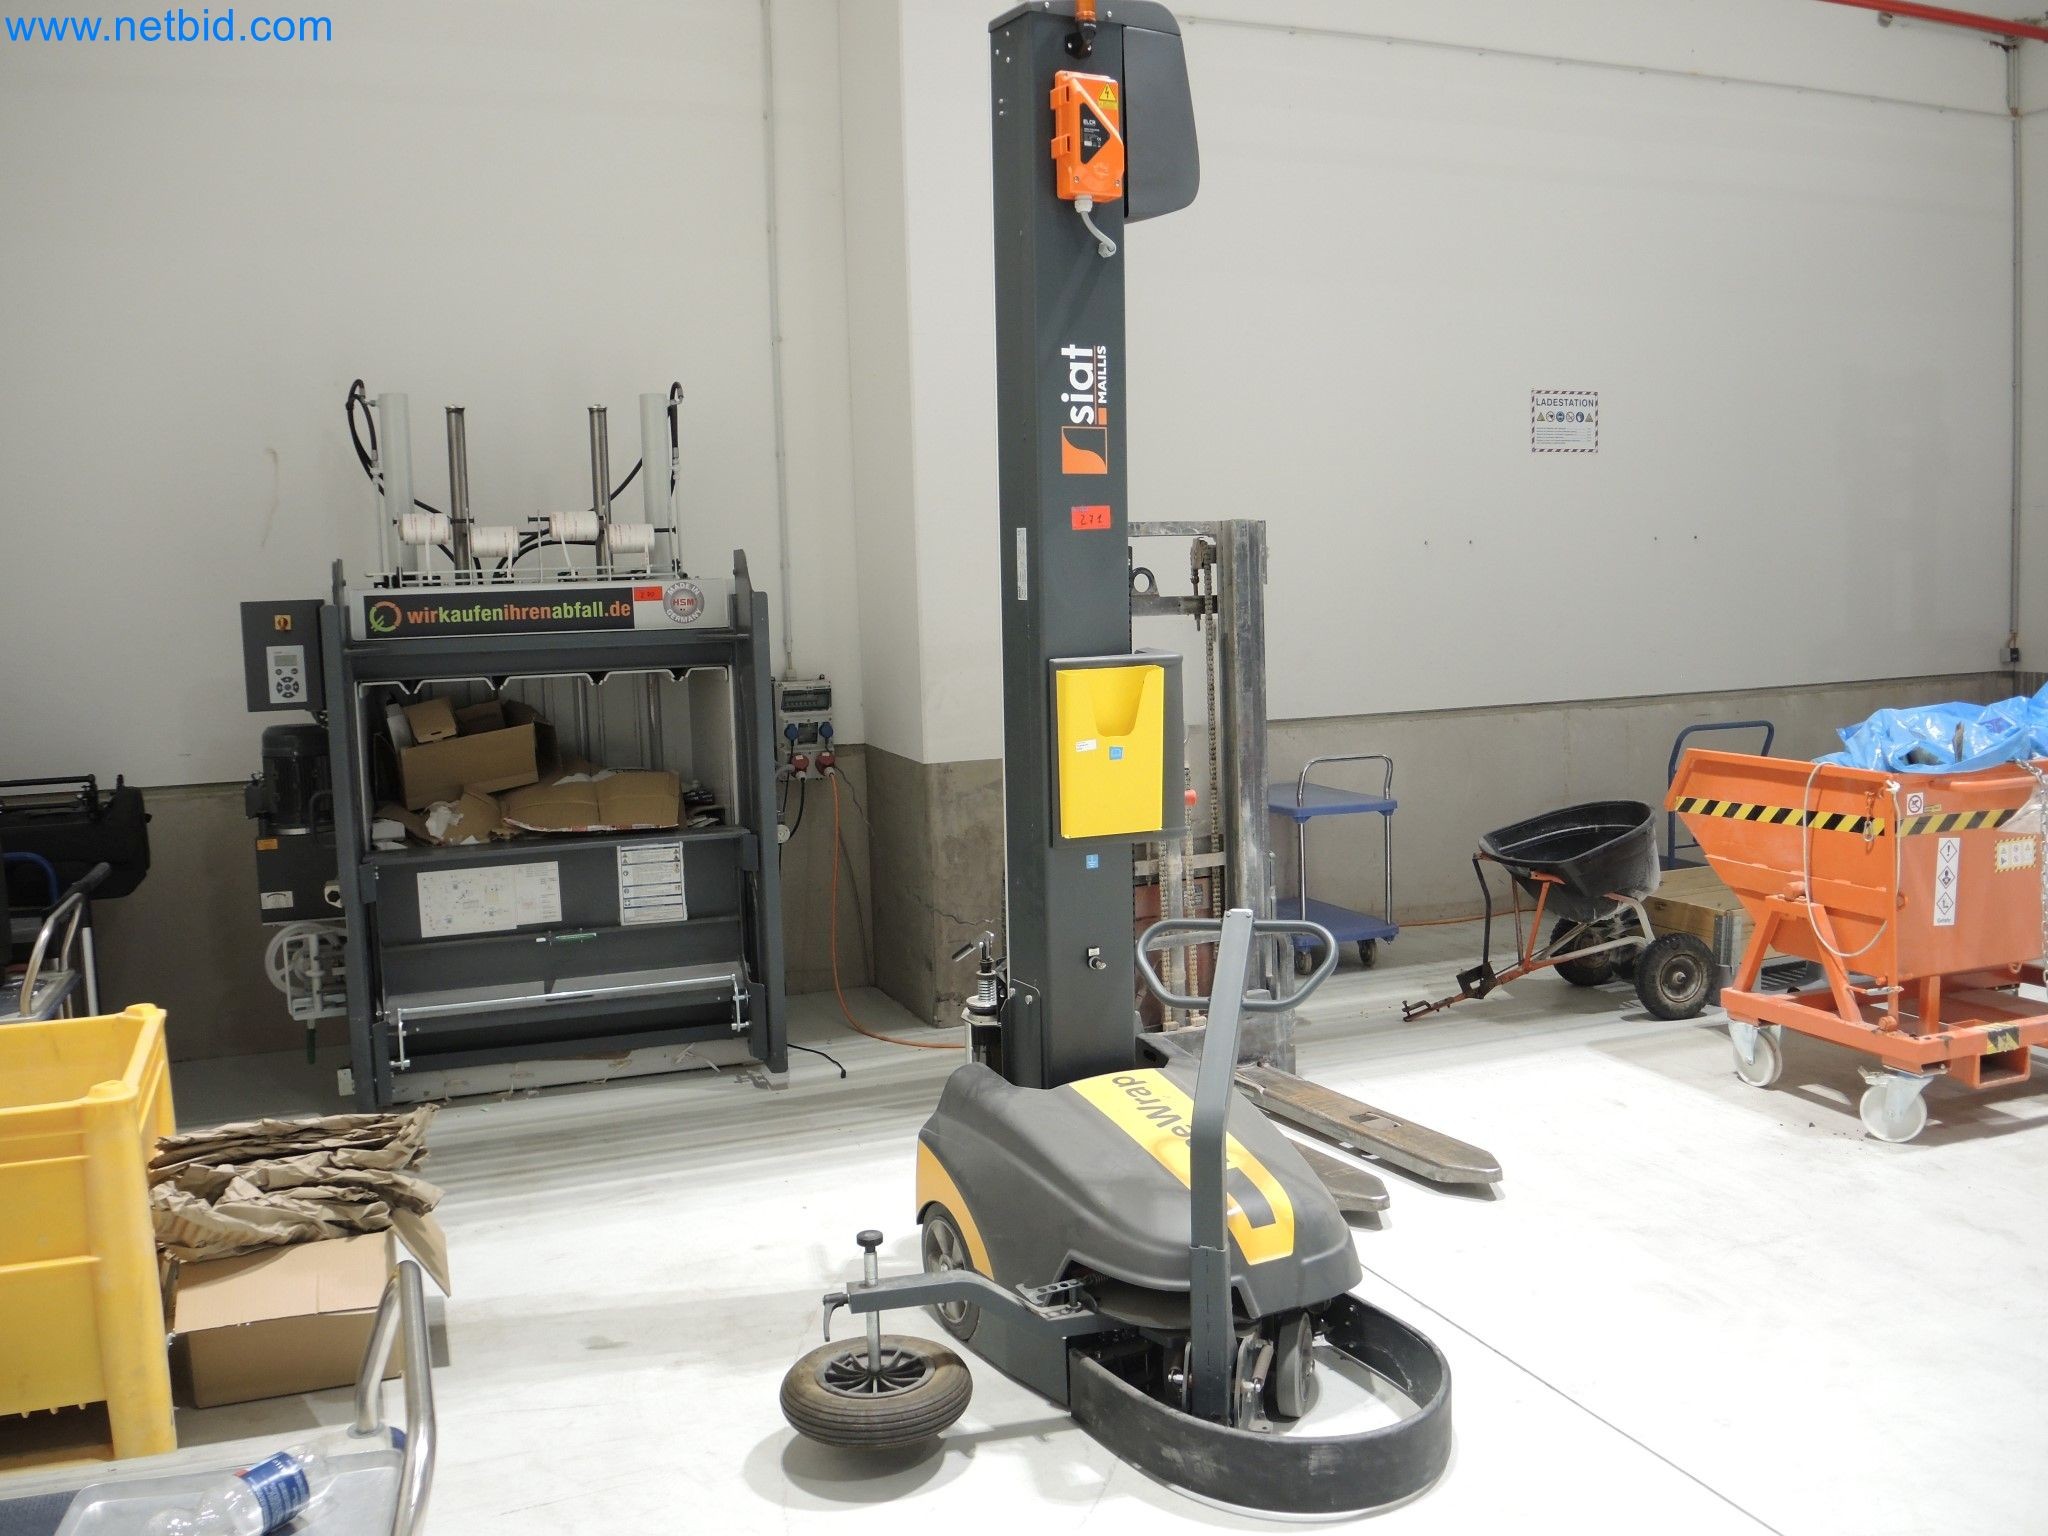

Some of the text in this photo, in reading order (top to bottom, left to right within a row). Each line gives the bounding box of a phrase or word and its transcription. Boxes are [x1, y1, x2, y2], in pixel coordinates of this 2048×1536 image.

[1061, 344, 1094, 425] siat
[1097, 345, 1107, 404] MAILLIS
[1536, 398, 1594, 407] LADESTATION
[667, 582, 701, 596] MADE IN
[672, 598, 695, 606] HSM
[406, 600, 632, 625] wirkaufenihrenabfall.de
[666, 608, 702, 624] GERMANY
[1111, 1076, 1197, 1150] eWrap
